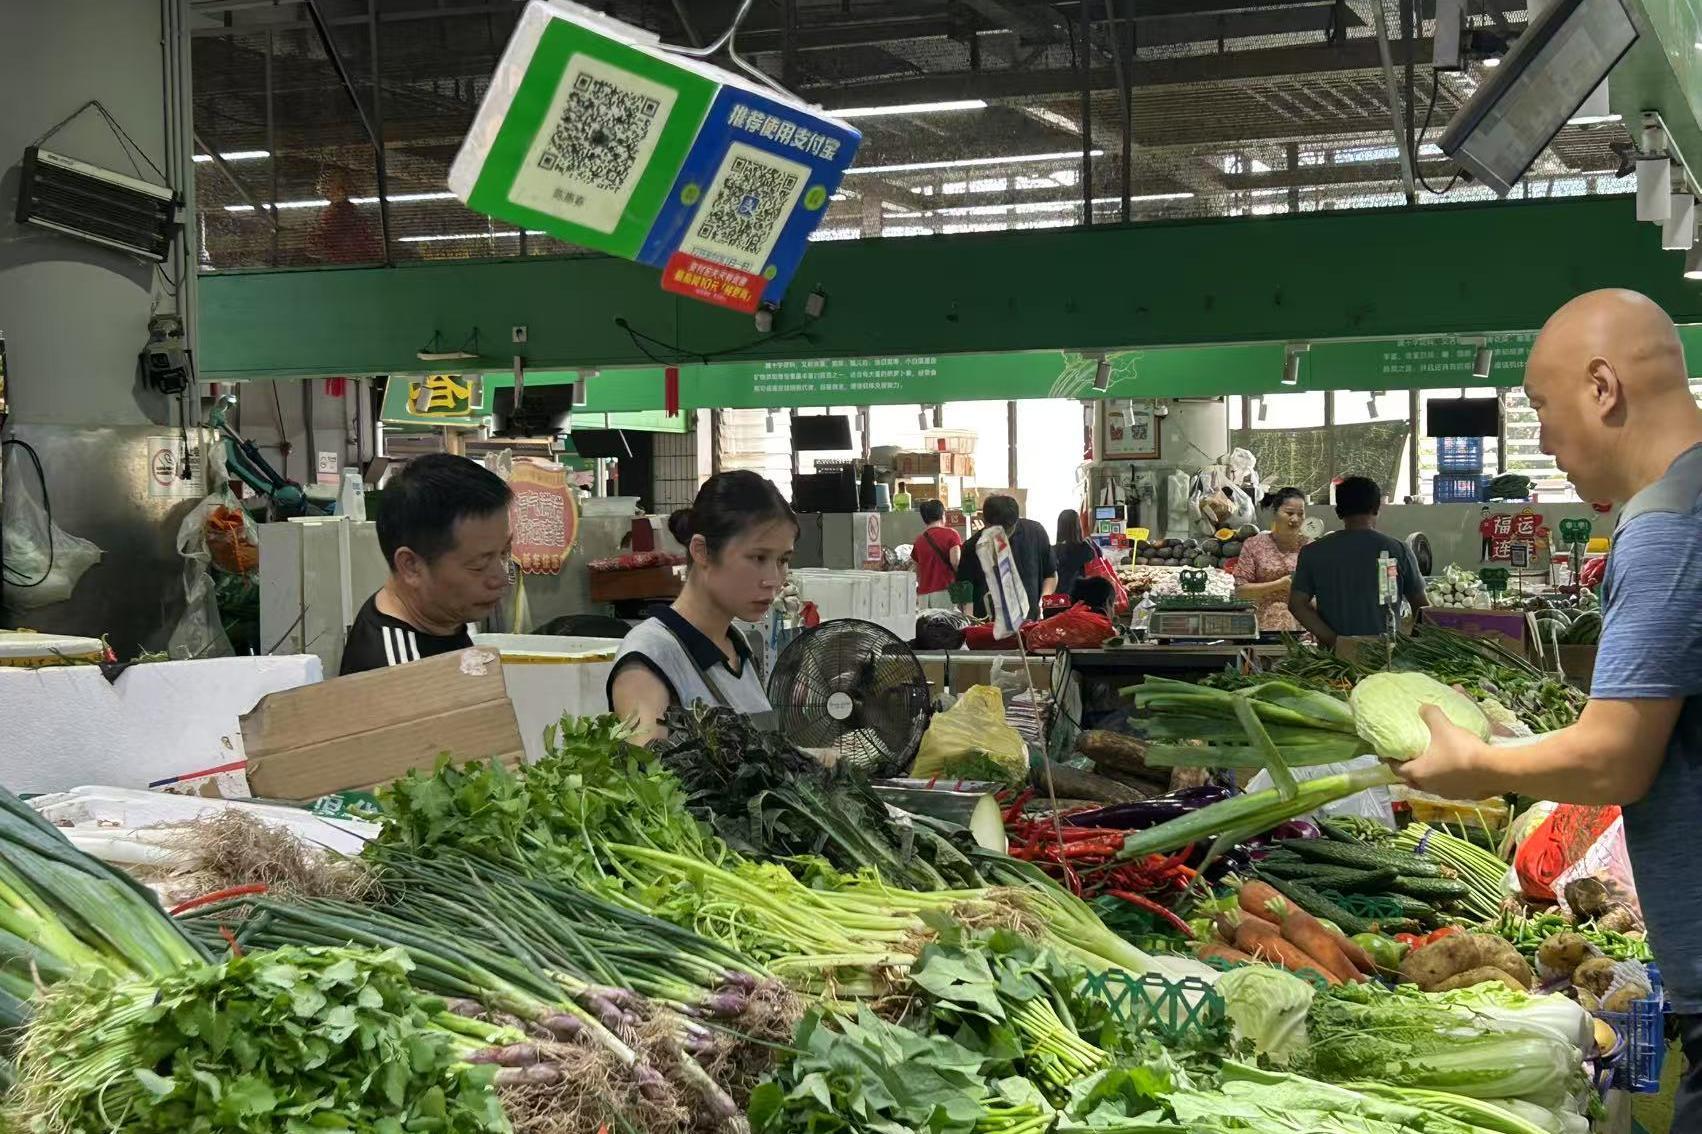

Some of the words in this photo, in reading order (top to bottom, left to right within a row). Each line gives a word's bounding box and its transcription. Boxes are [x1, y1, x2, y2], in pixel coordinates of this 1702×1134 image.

[728, 104, 841, 161] 推荐使用支付宝
[1494, 515, 1534, 535] 福运
